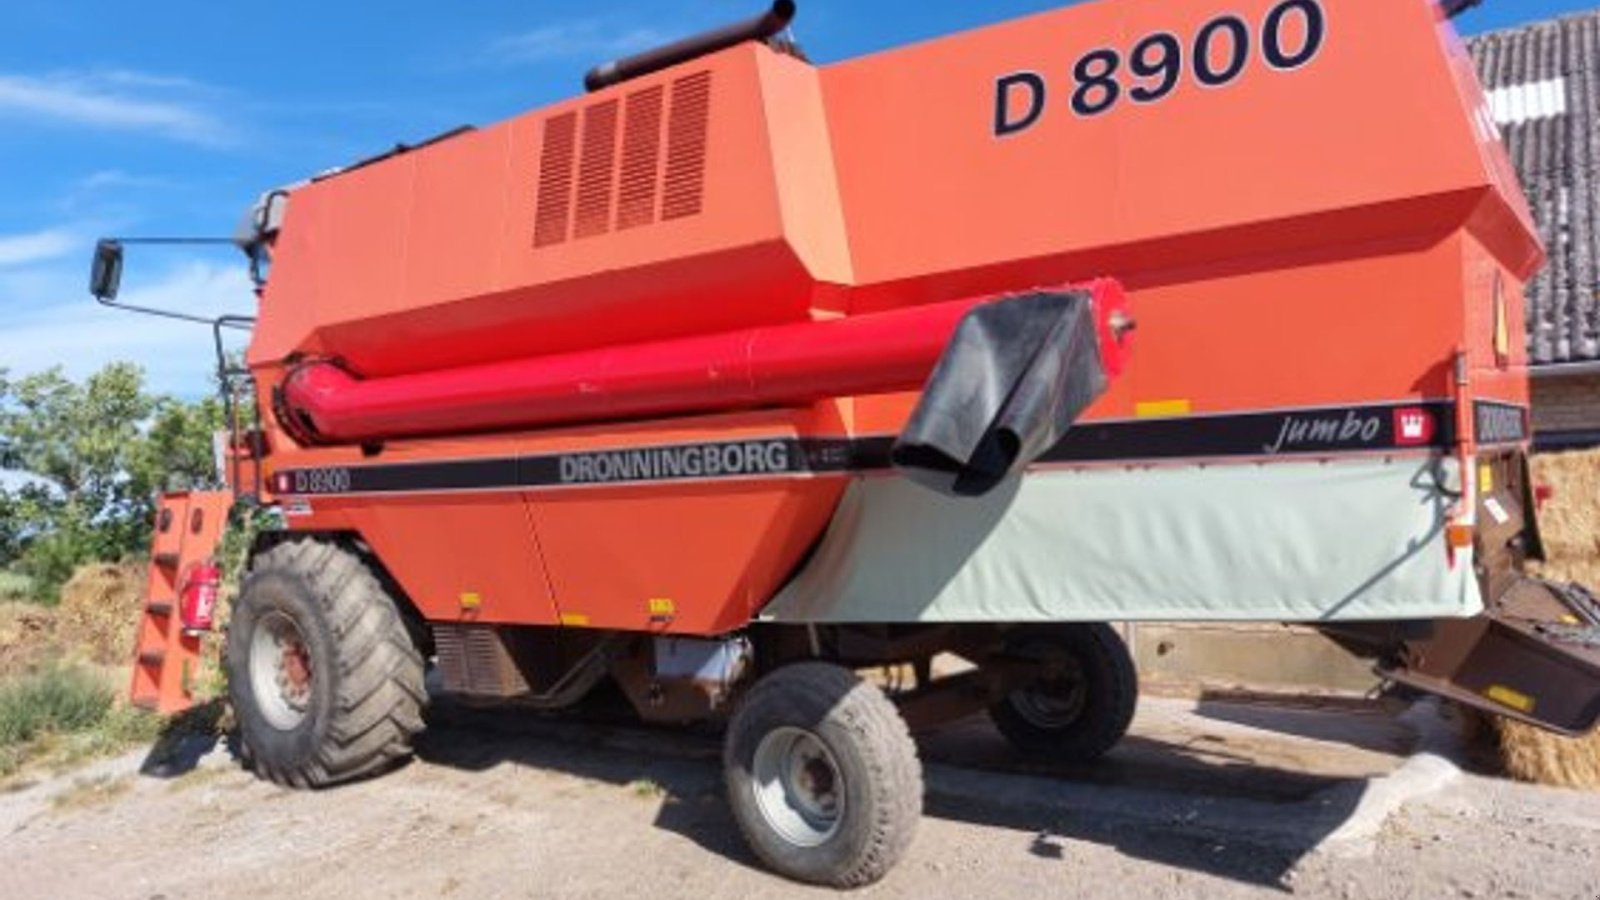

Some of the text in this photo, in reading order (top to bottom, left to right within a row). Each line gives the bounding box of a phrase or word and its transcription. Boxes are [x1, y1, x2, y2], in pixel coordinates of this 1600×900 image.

[993, 0, 1325, 137] D 8900
[1263, 410, 1381, 454] jumbo
[295, 469, 308, 492] D
[559, 441, 788, 482] DRONNINGBORG
